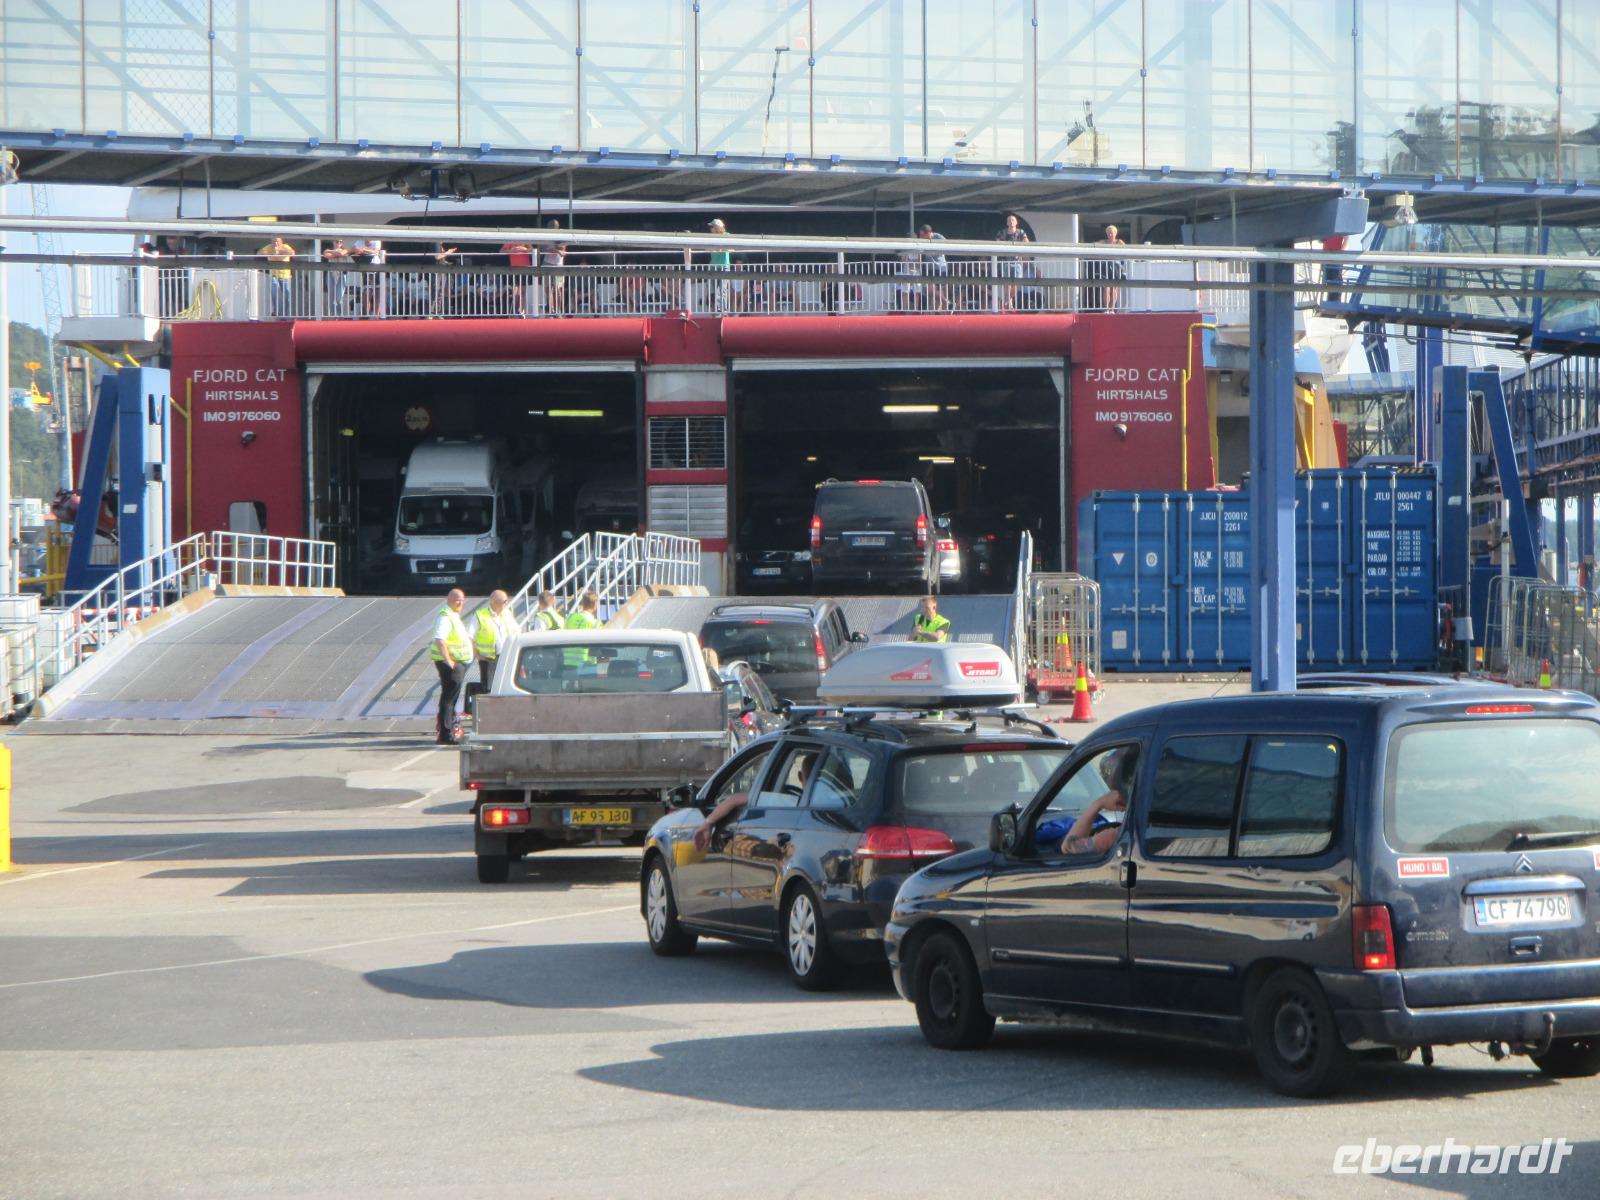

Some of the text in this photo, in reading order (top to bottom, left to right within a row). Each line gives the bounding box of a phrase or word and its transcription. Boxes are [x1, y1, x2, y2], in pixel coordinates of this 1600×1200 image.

[193, 369, 287, 383] FJORD CAT
[1085, 368, 1180, 382] FJORD CAT
[205, 390, 279, 401] HIRTSHALS
[1097, 389, 1168, 400] HIRTSHALS
[203, 411, 281, 422] IMO 9176060
[1095, 411, 1173, 422] IMO 9176060
[572, 810, 629, 822] AF 95 130
[1403, 863, 1425, 873] HUND
[1431, 862, 1445, 872] BIL
[1488, 900, 1508, 920] CF
